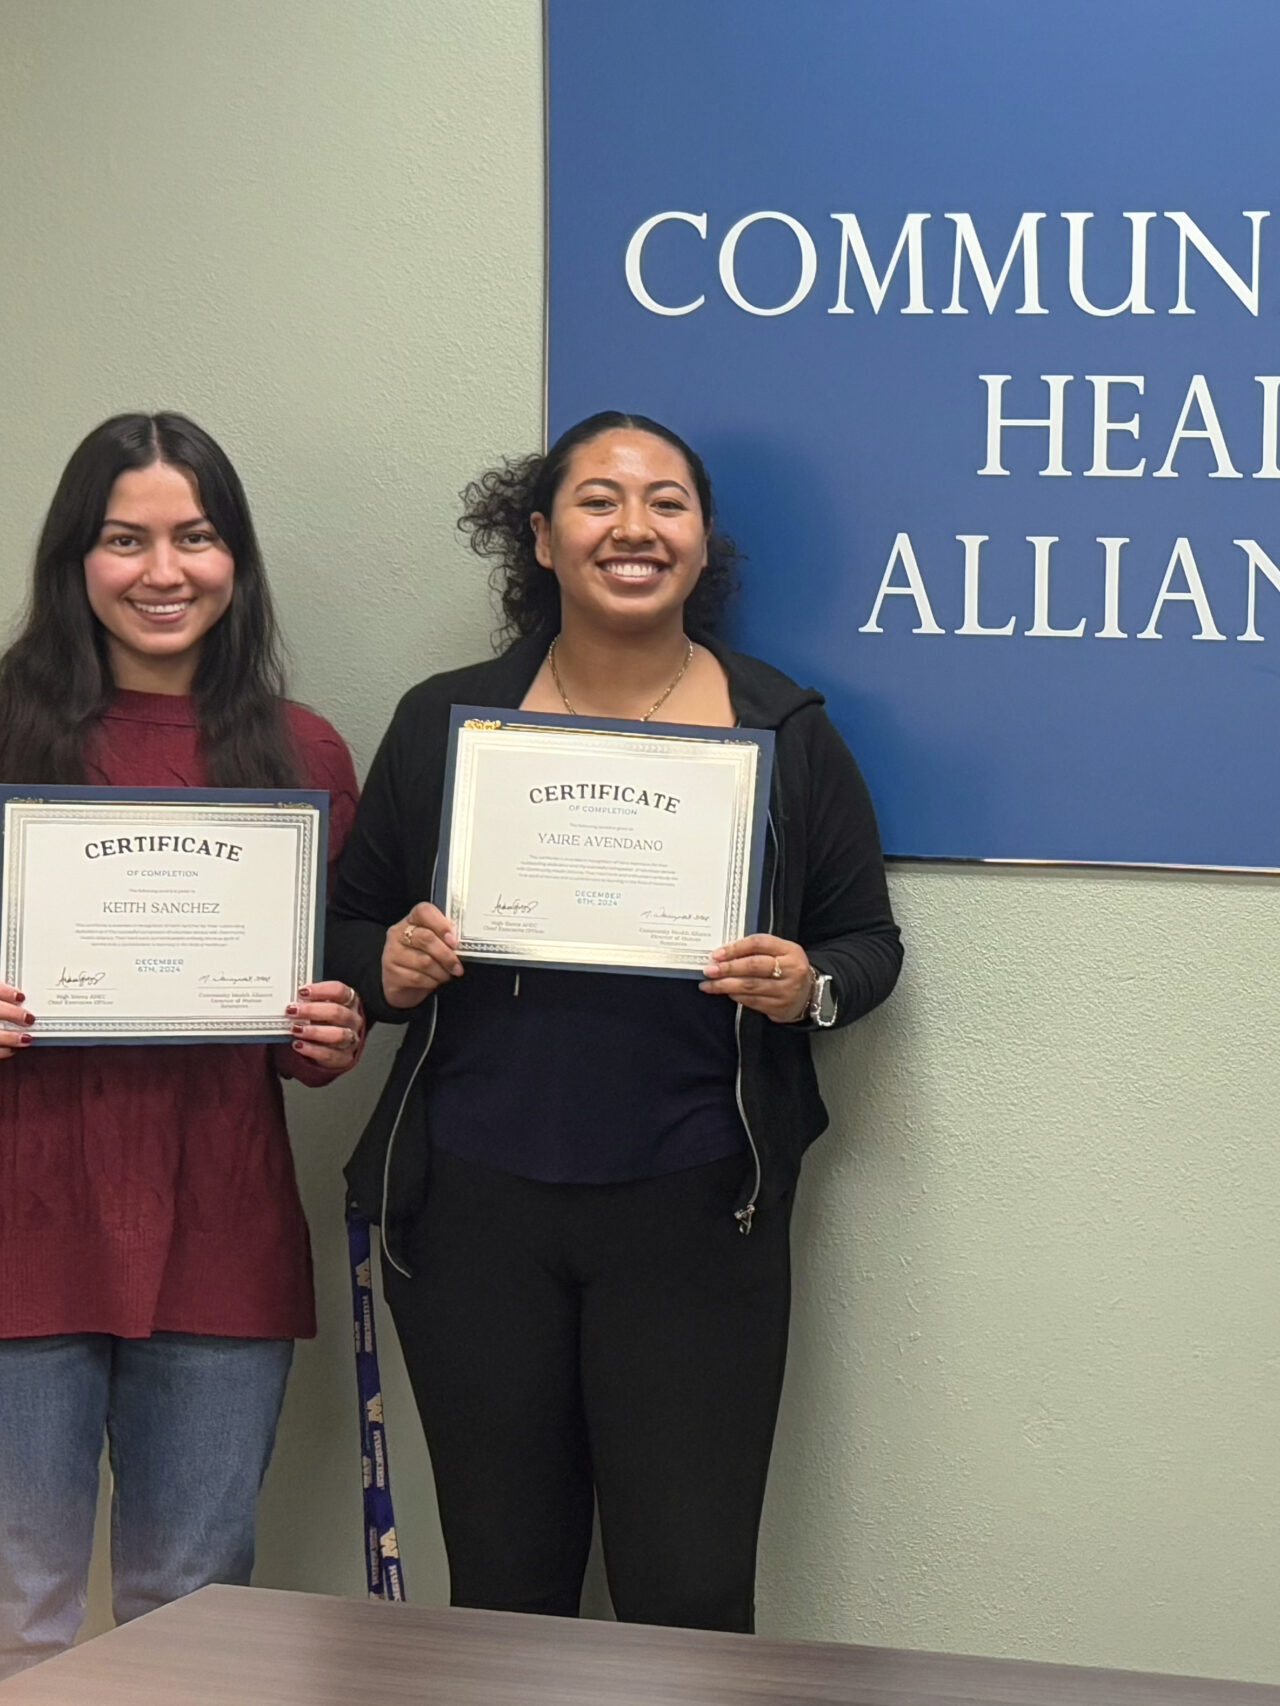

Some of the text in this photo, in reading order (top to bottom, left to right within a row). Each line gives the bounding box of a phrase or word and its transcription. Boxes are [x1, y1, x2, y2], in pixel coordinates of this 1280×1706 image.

[530, 783, 680, 814] CERTIFICATE
[582, 806, 638, 815] COMPLETION
[84, 835, 243, 862] CERTIFICATE
[538, 833, 663, 851] YAIRE AVENDANO
[575, 890, 621, 899] DECEMBER
[103, 902, 220, 914] KEITH SANCHEZ
[380, 1527, 399, 1558] W
